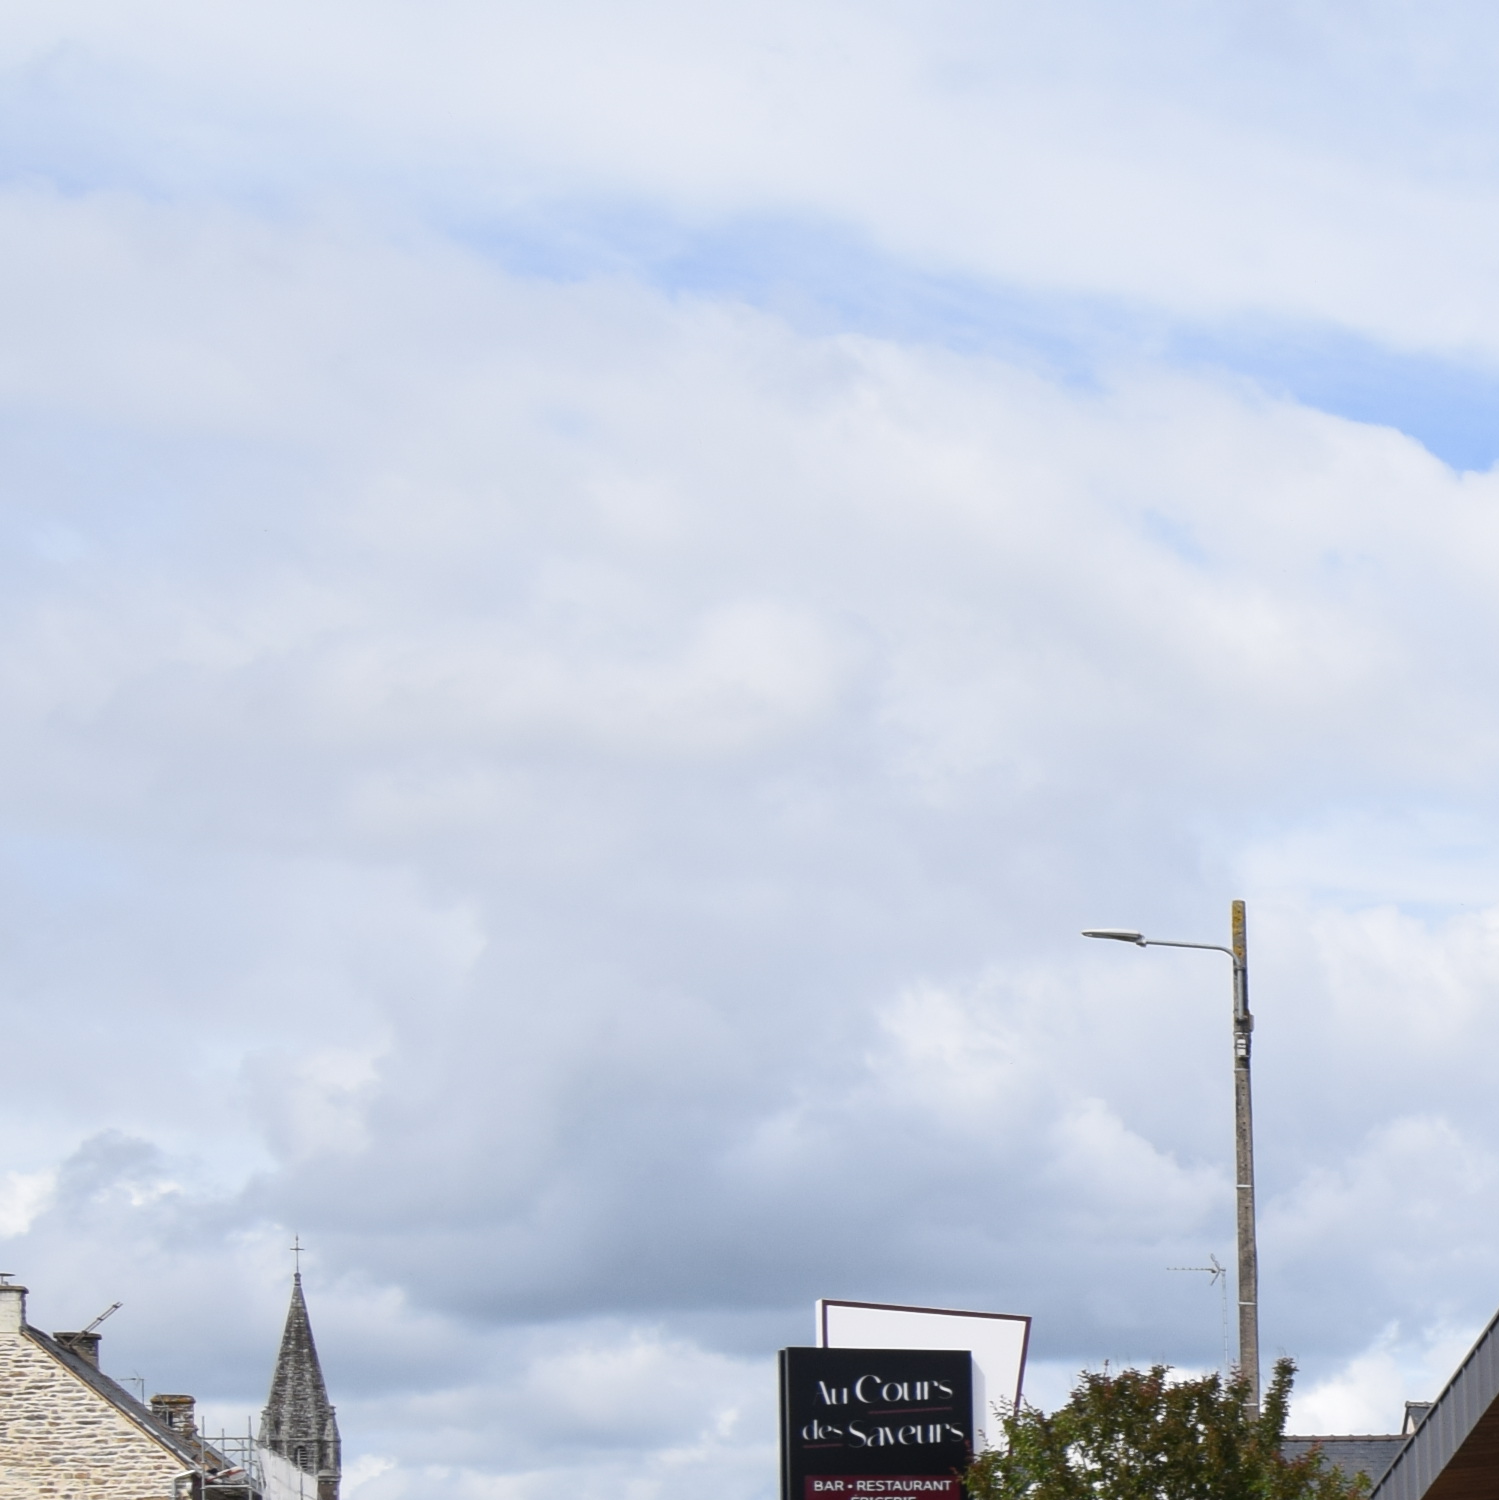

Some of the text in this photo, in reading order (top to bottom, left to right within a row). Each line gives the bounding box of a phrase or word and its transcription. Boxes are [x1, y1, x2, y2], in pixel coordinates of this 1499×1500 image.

[812, 1374, 953, 1405] Au Cours
[802, 1418, 964, 1448] des Saveurs
[813, 1480, 952, 1491] BAR RESTAURANT
